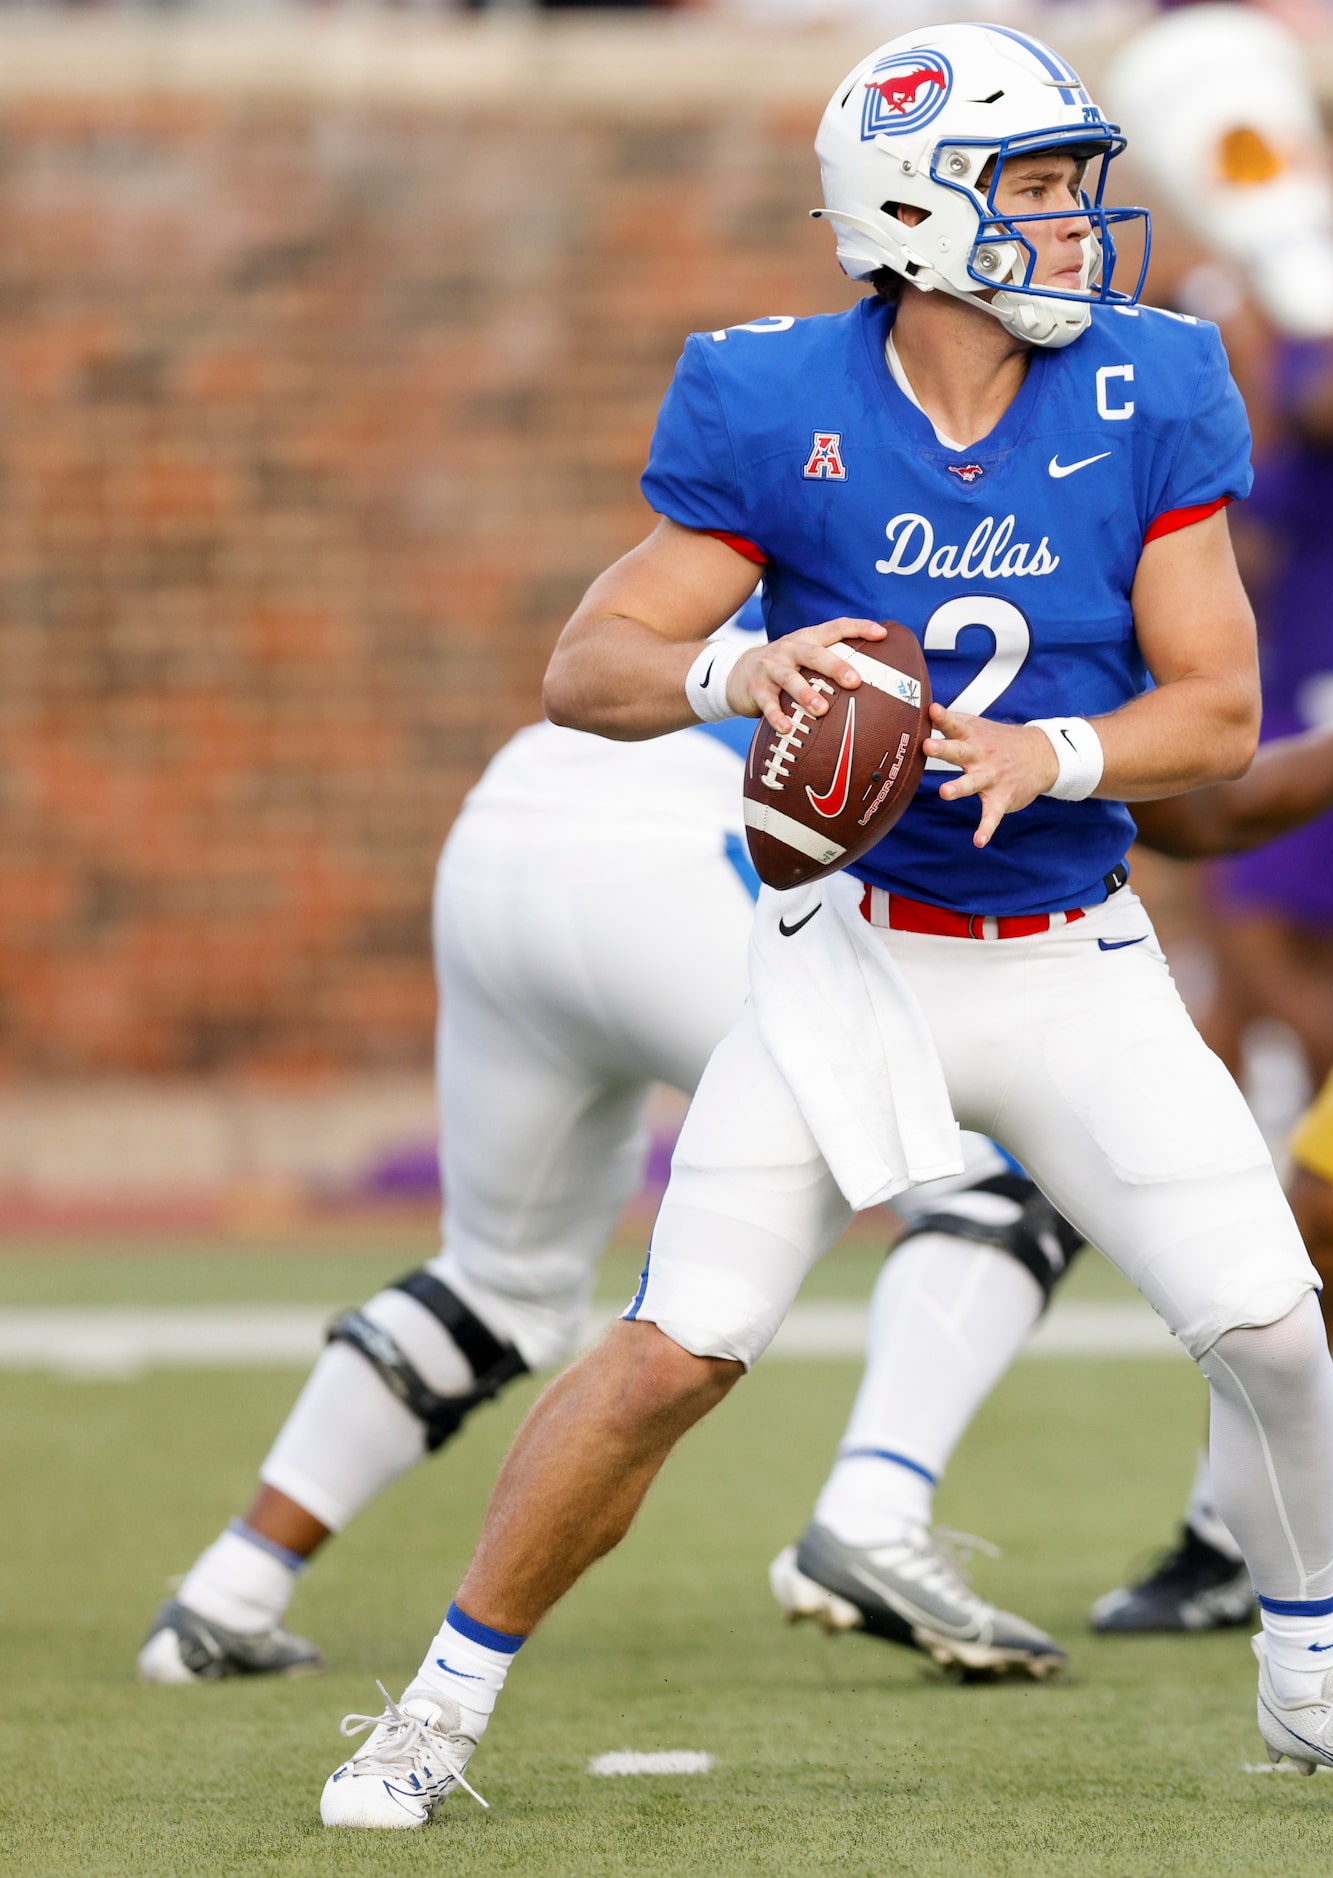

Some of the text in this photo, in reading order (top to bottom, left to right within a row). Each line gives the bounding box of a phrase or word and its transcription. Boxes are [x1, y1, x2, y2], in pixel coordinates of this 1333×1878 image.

[1096, 364, 1135, 420] C
[803, 432, 846, 479] A
[875, 512, 1060, 579] Dallas
[922, 594, 1031, 773] 2
[857, 732, 911, 827] VAPOR ELITE
